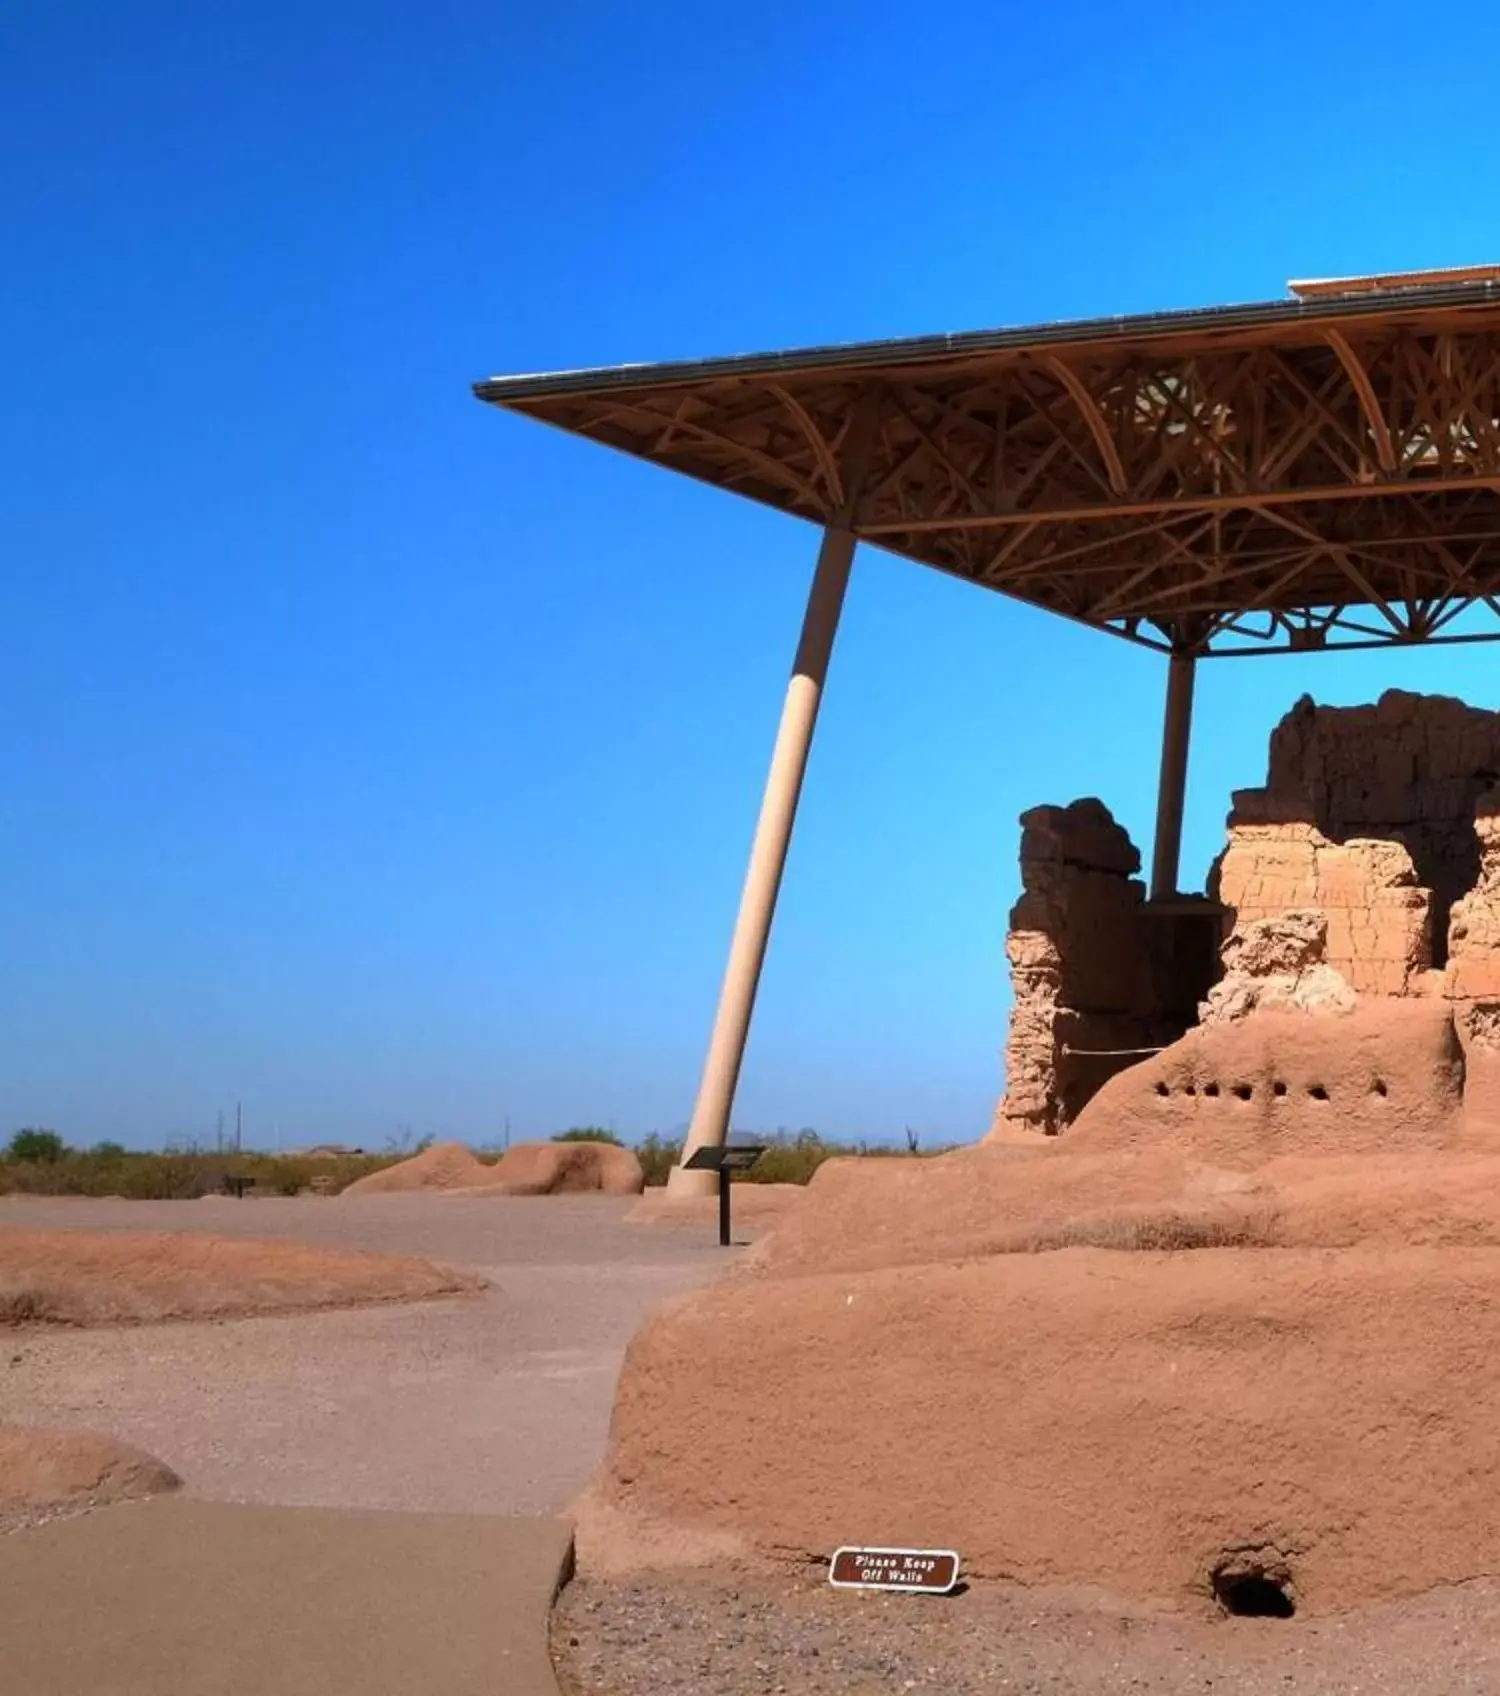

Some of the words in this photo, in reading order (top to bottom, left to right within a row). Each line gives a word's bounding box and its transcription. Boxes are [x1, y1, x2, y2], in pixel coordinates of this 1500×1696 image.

[855, 1555, 897, 1568] Please
[903, 1557, 935, 1571] Keep
[861, 1569, 882, 1581] Off
[888, 1570, 923, 1582] Walls
